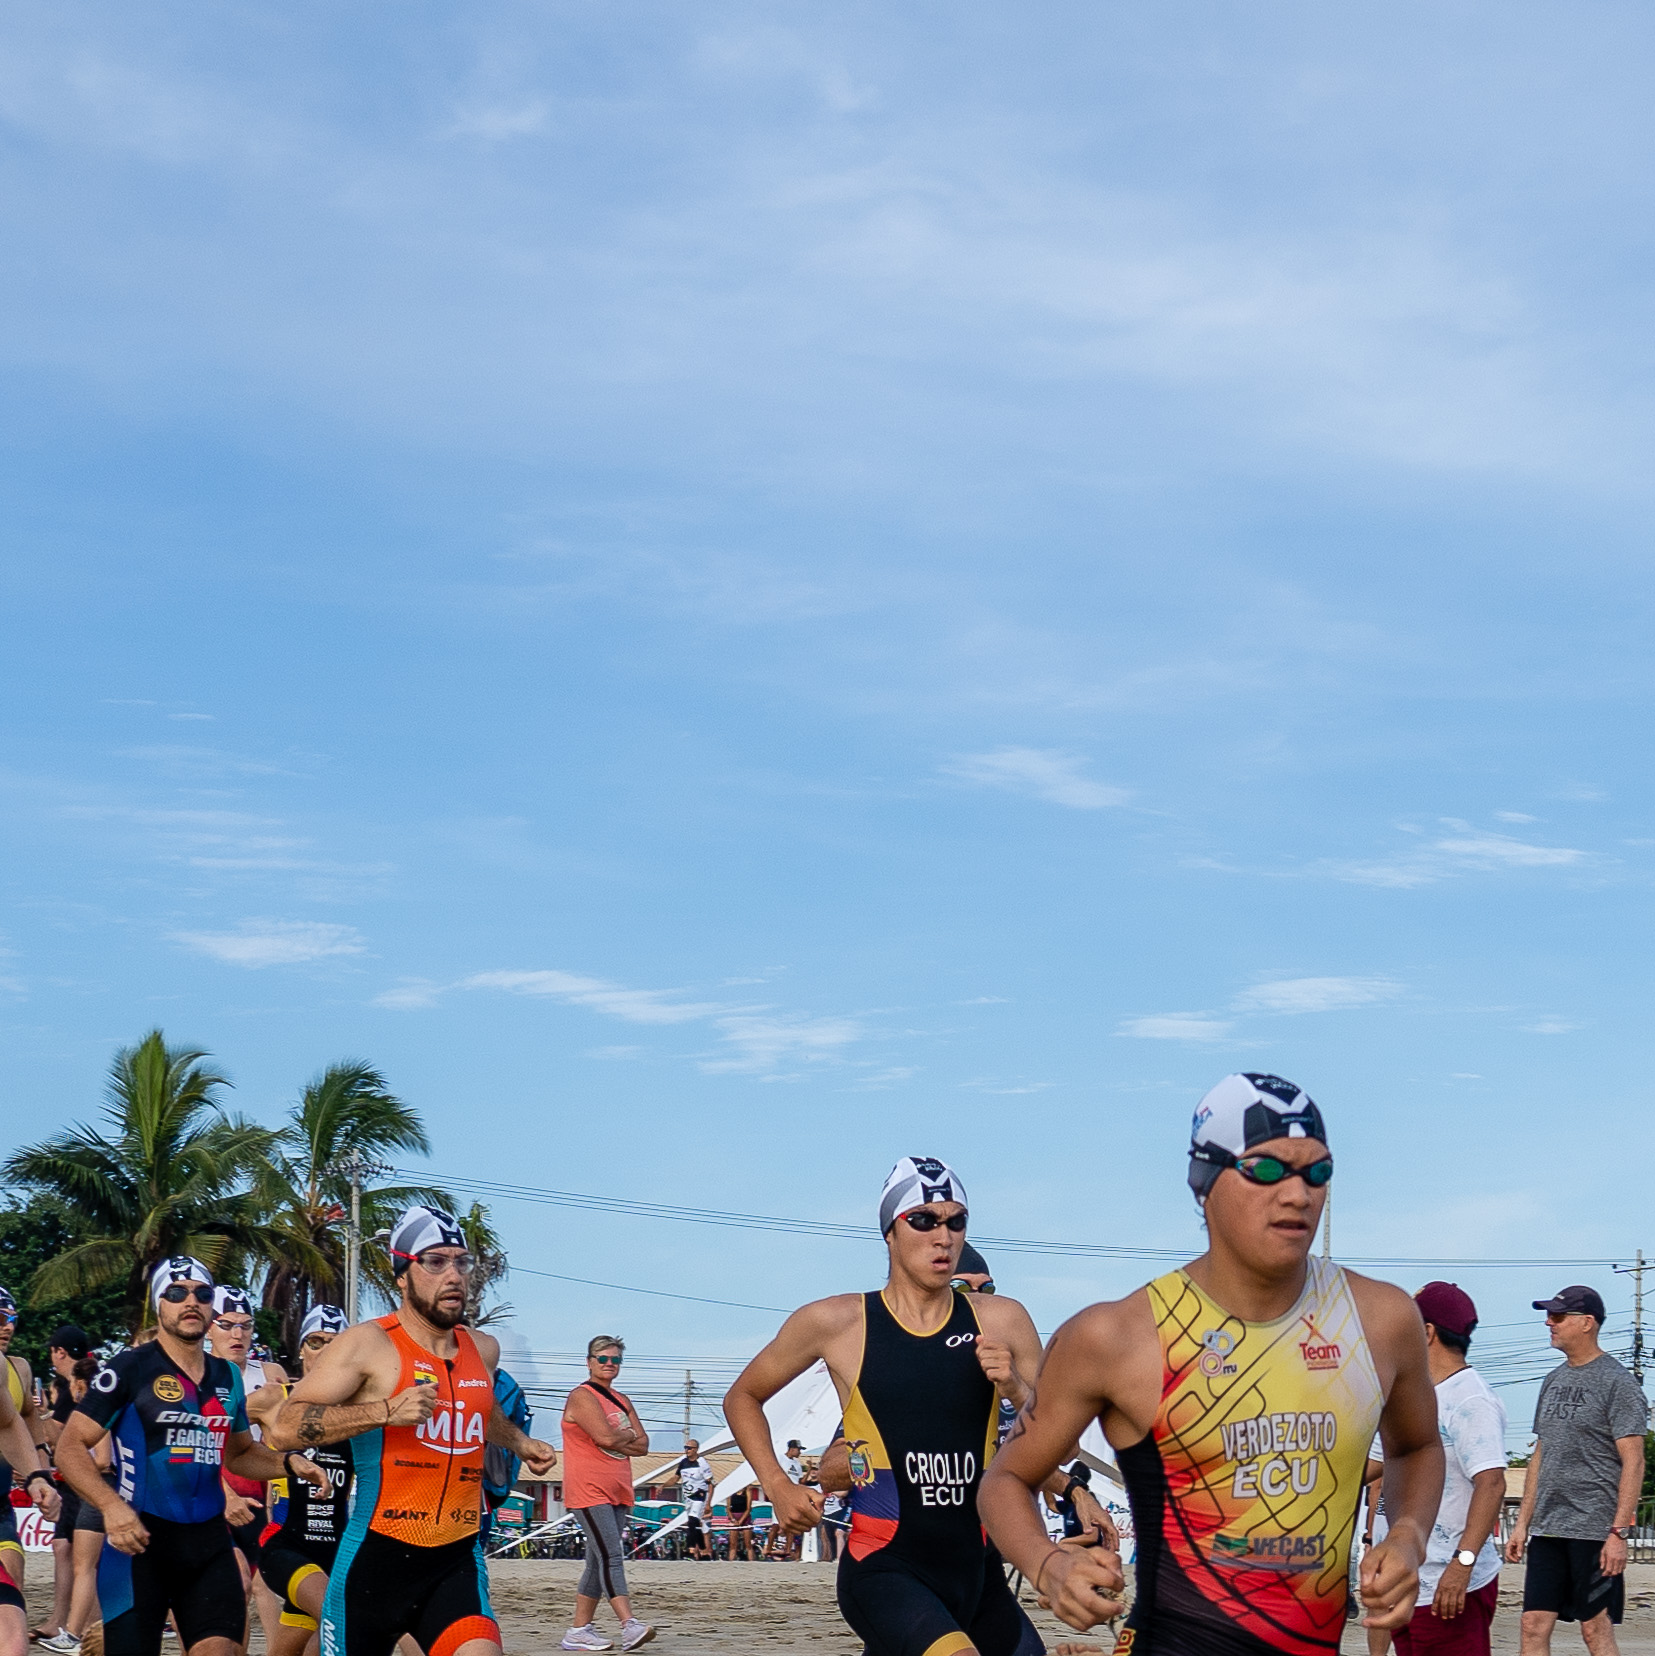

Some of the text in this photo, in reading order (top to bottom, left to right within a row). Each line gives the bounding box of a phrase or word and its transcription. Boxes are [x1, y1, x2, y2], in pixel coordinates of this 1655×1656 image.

[1299, 1342, 1341, 1361] Team
[155, 1410, 234, 1428] GIANT
[1220, 1411, 1338, 1462] VERDEZOTO
[193, 1447, 222, 1466] ECU
[905, 1451, 976, 1485] CRIOLLO
[1231, 1455, 1320, 1499] ECU
[920, 1485, 965, 1506] ECU
